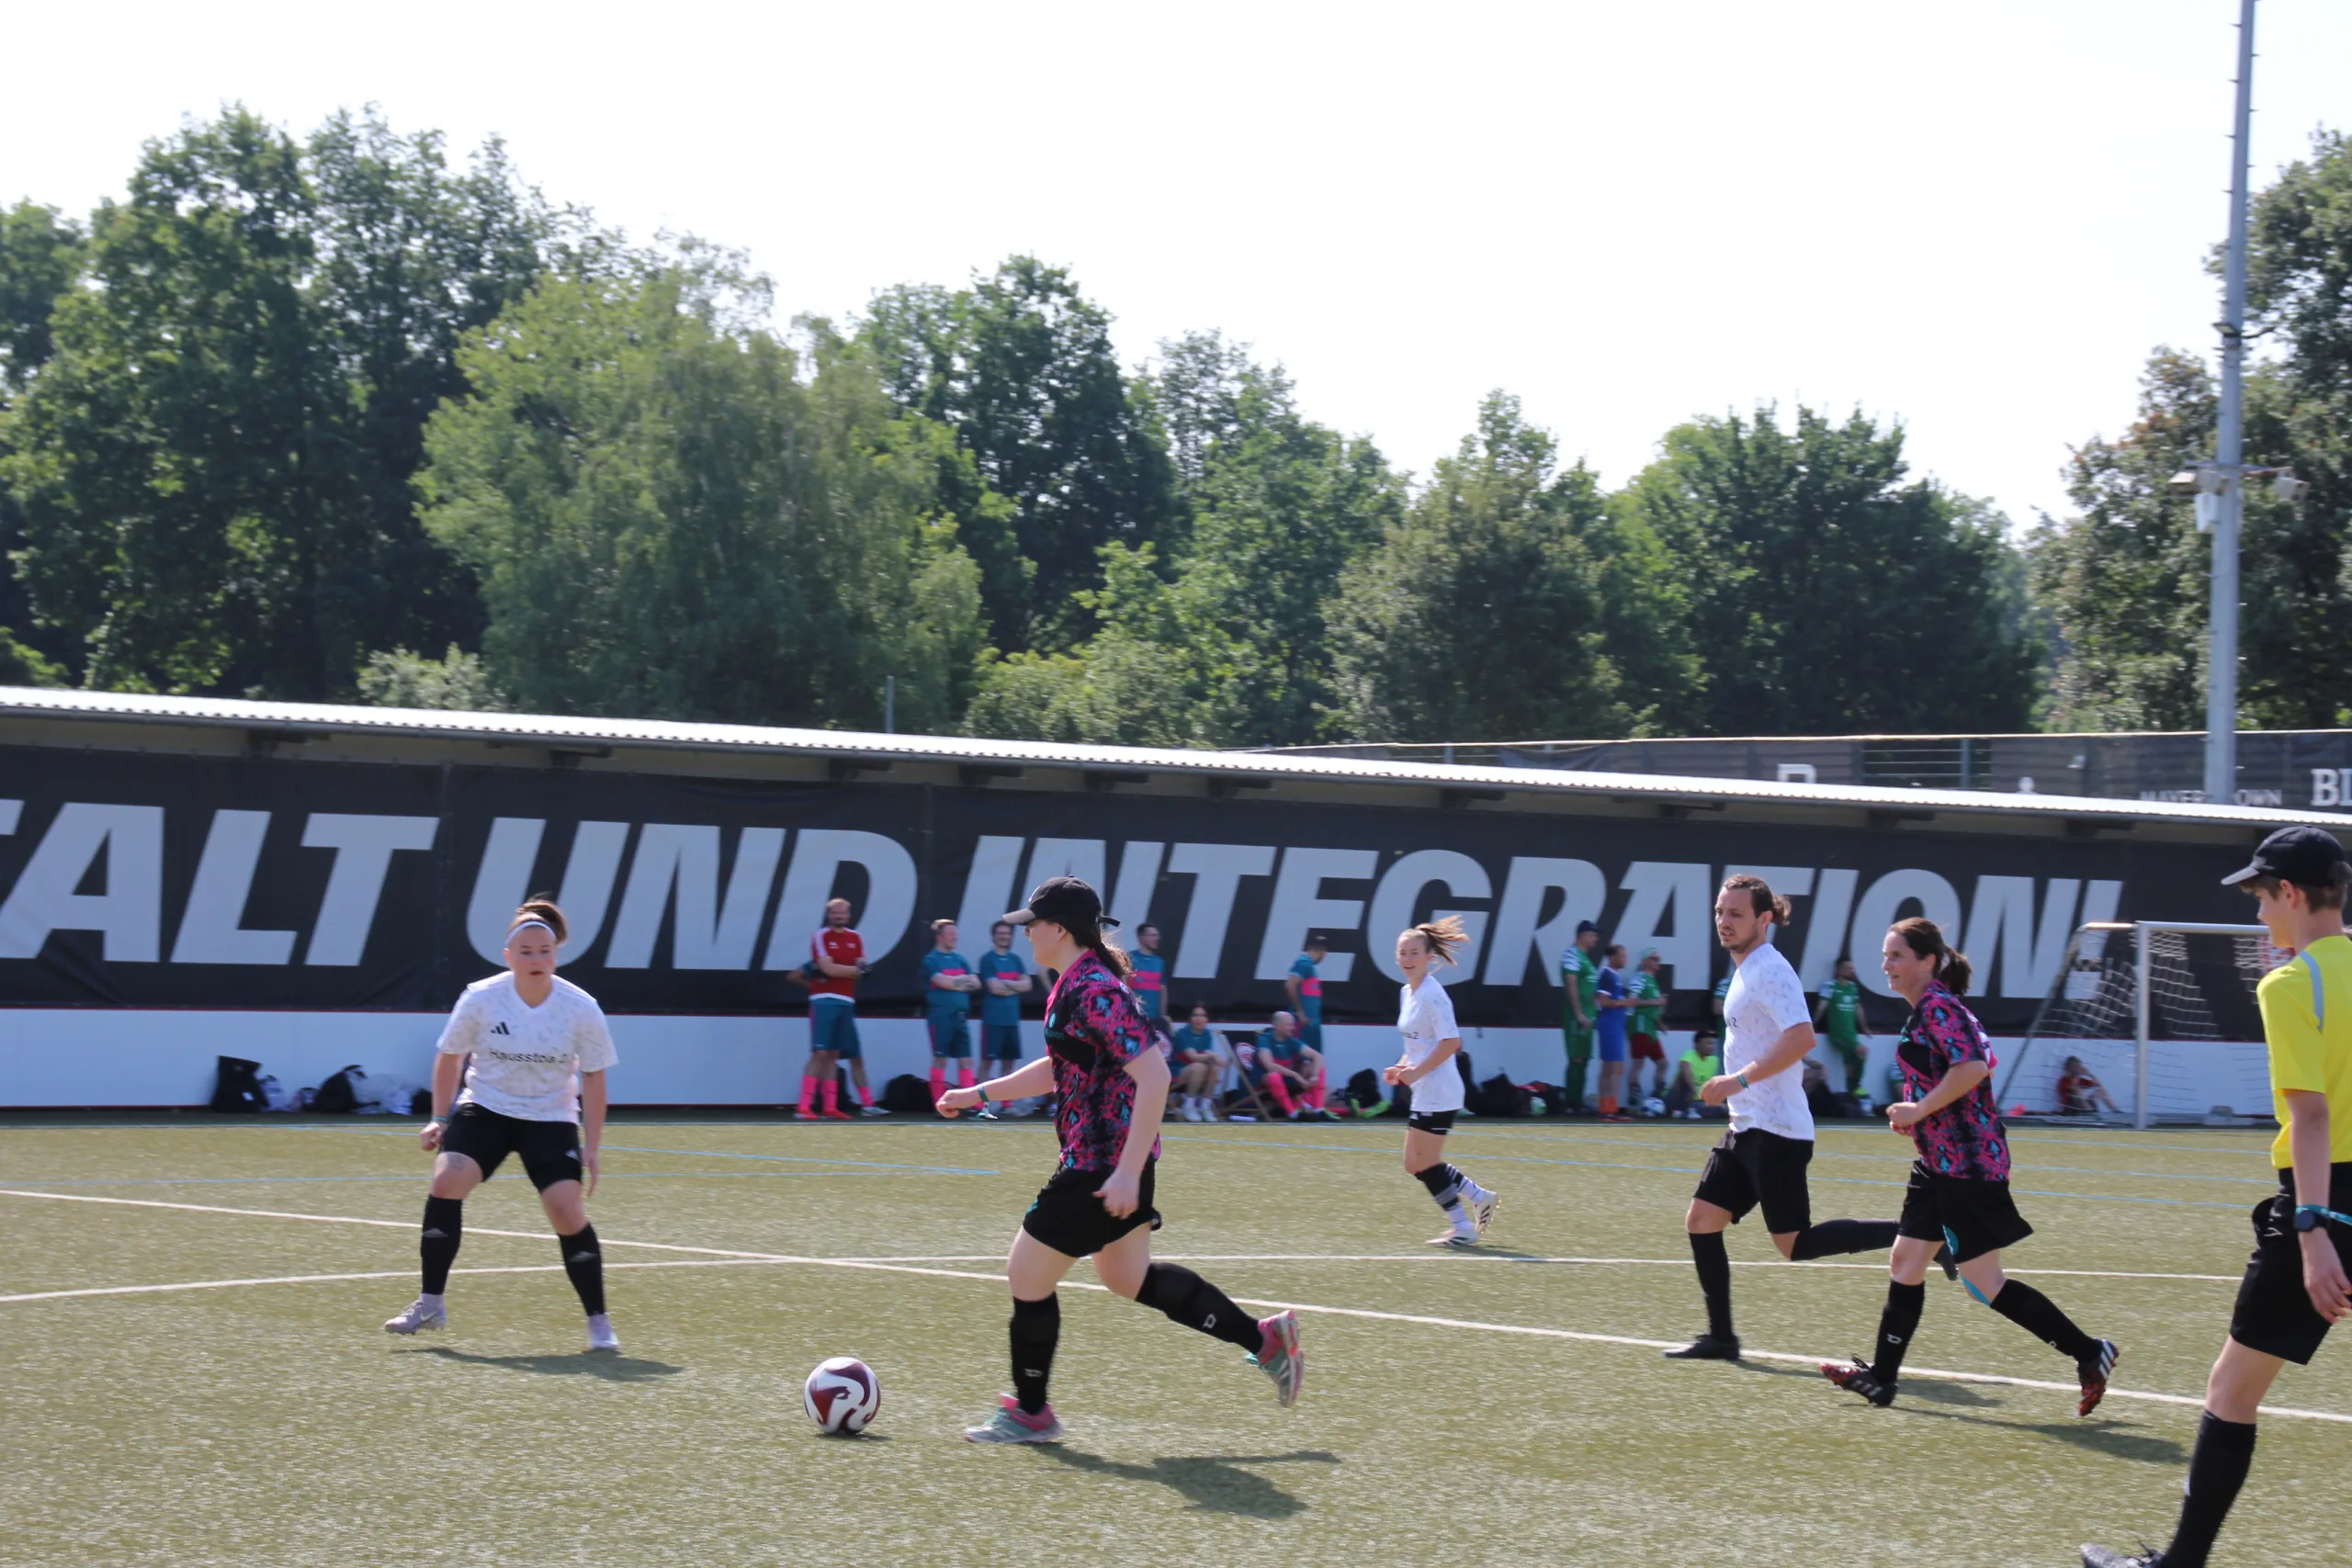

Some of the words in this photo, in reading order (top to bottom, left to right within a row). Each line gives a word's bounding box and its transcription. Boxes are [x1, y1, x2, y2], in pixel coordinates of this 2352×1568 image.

[2233, 789, 2282, 807] OWN
[0, 799, 440, 966] ALT
[466, 817, 918, 970] UND
